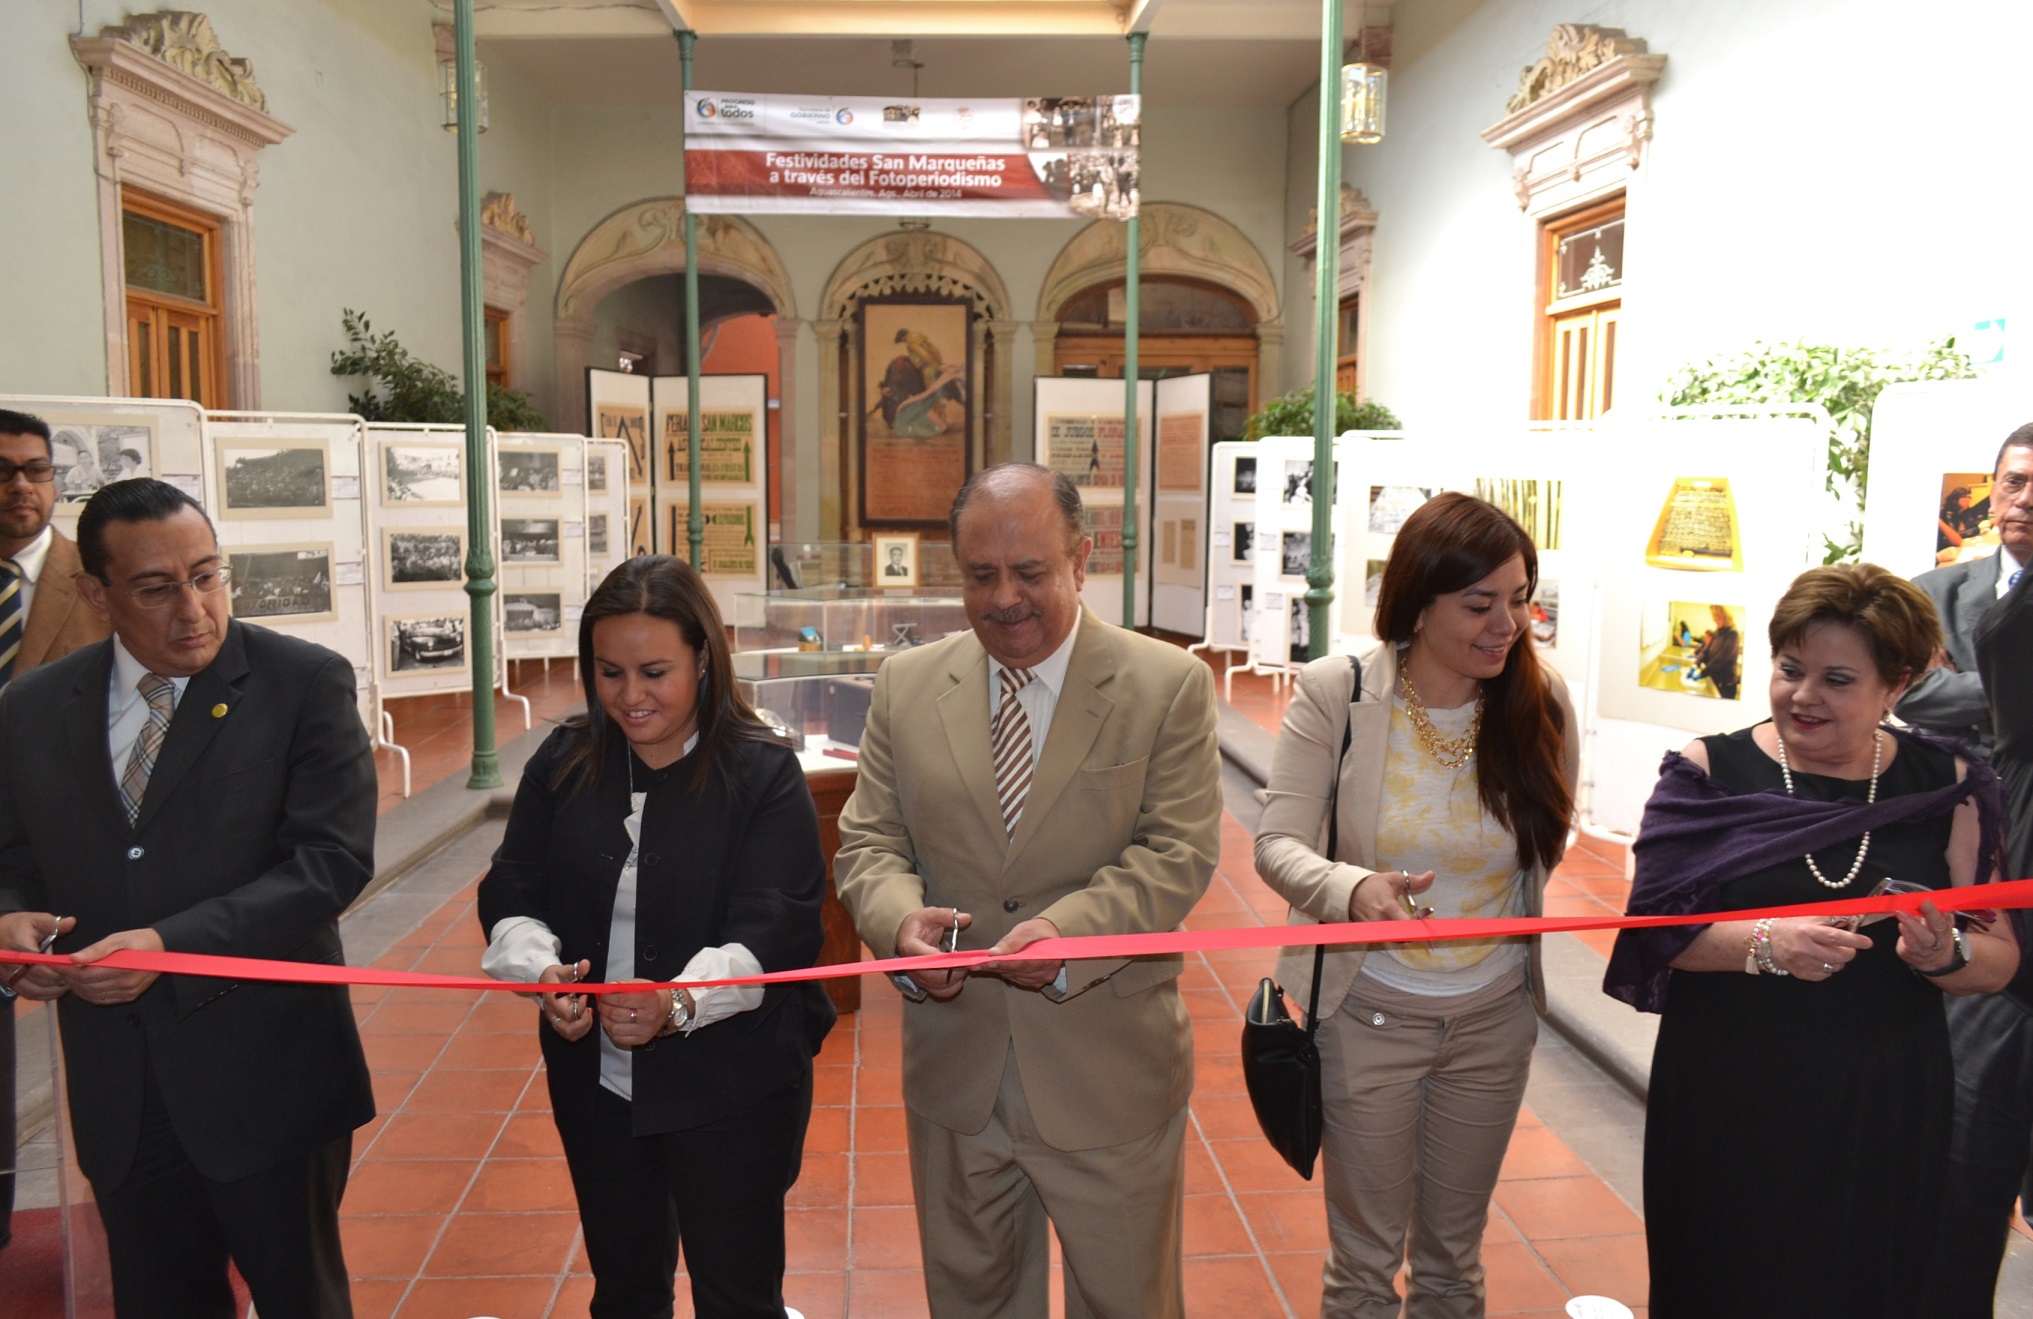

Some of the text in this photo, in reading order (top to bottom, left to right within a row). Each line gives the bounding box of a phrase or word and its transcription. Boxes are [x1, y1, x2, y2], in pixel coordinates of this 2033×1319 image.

[720, 108, 754, 118] todos
[790, 111, 831, 119] GOBIERNO
[766, 152, 1006, 172] Festividades San Marqueñas
[769, 169, 1002, 188] a través del Fotoperiodismo
[902, 189, 924, 198] Abril
[926, 189, 938, 198] de
[939, 189, 963, 199] 2014
[701, 414, 717, 432] SAN
[719, 414, 752, 432] MARCOS
